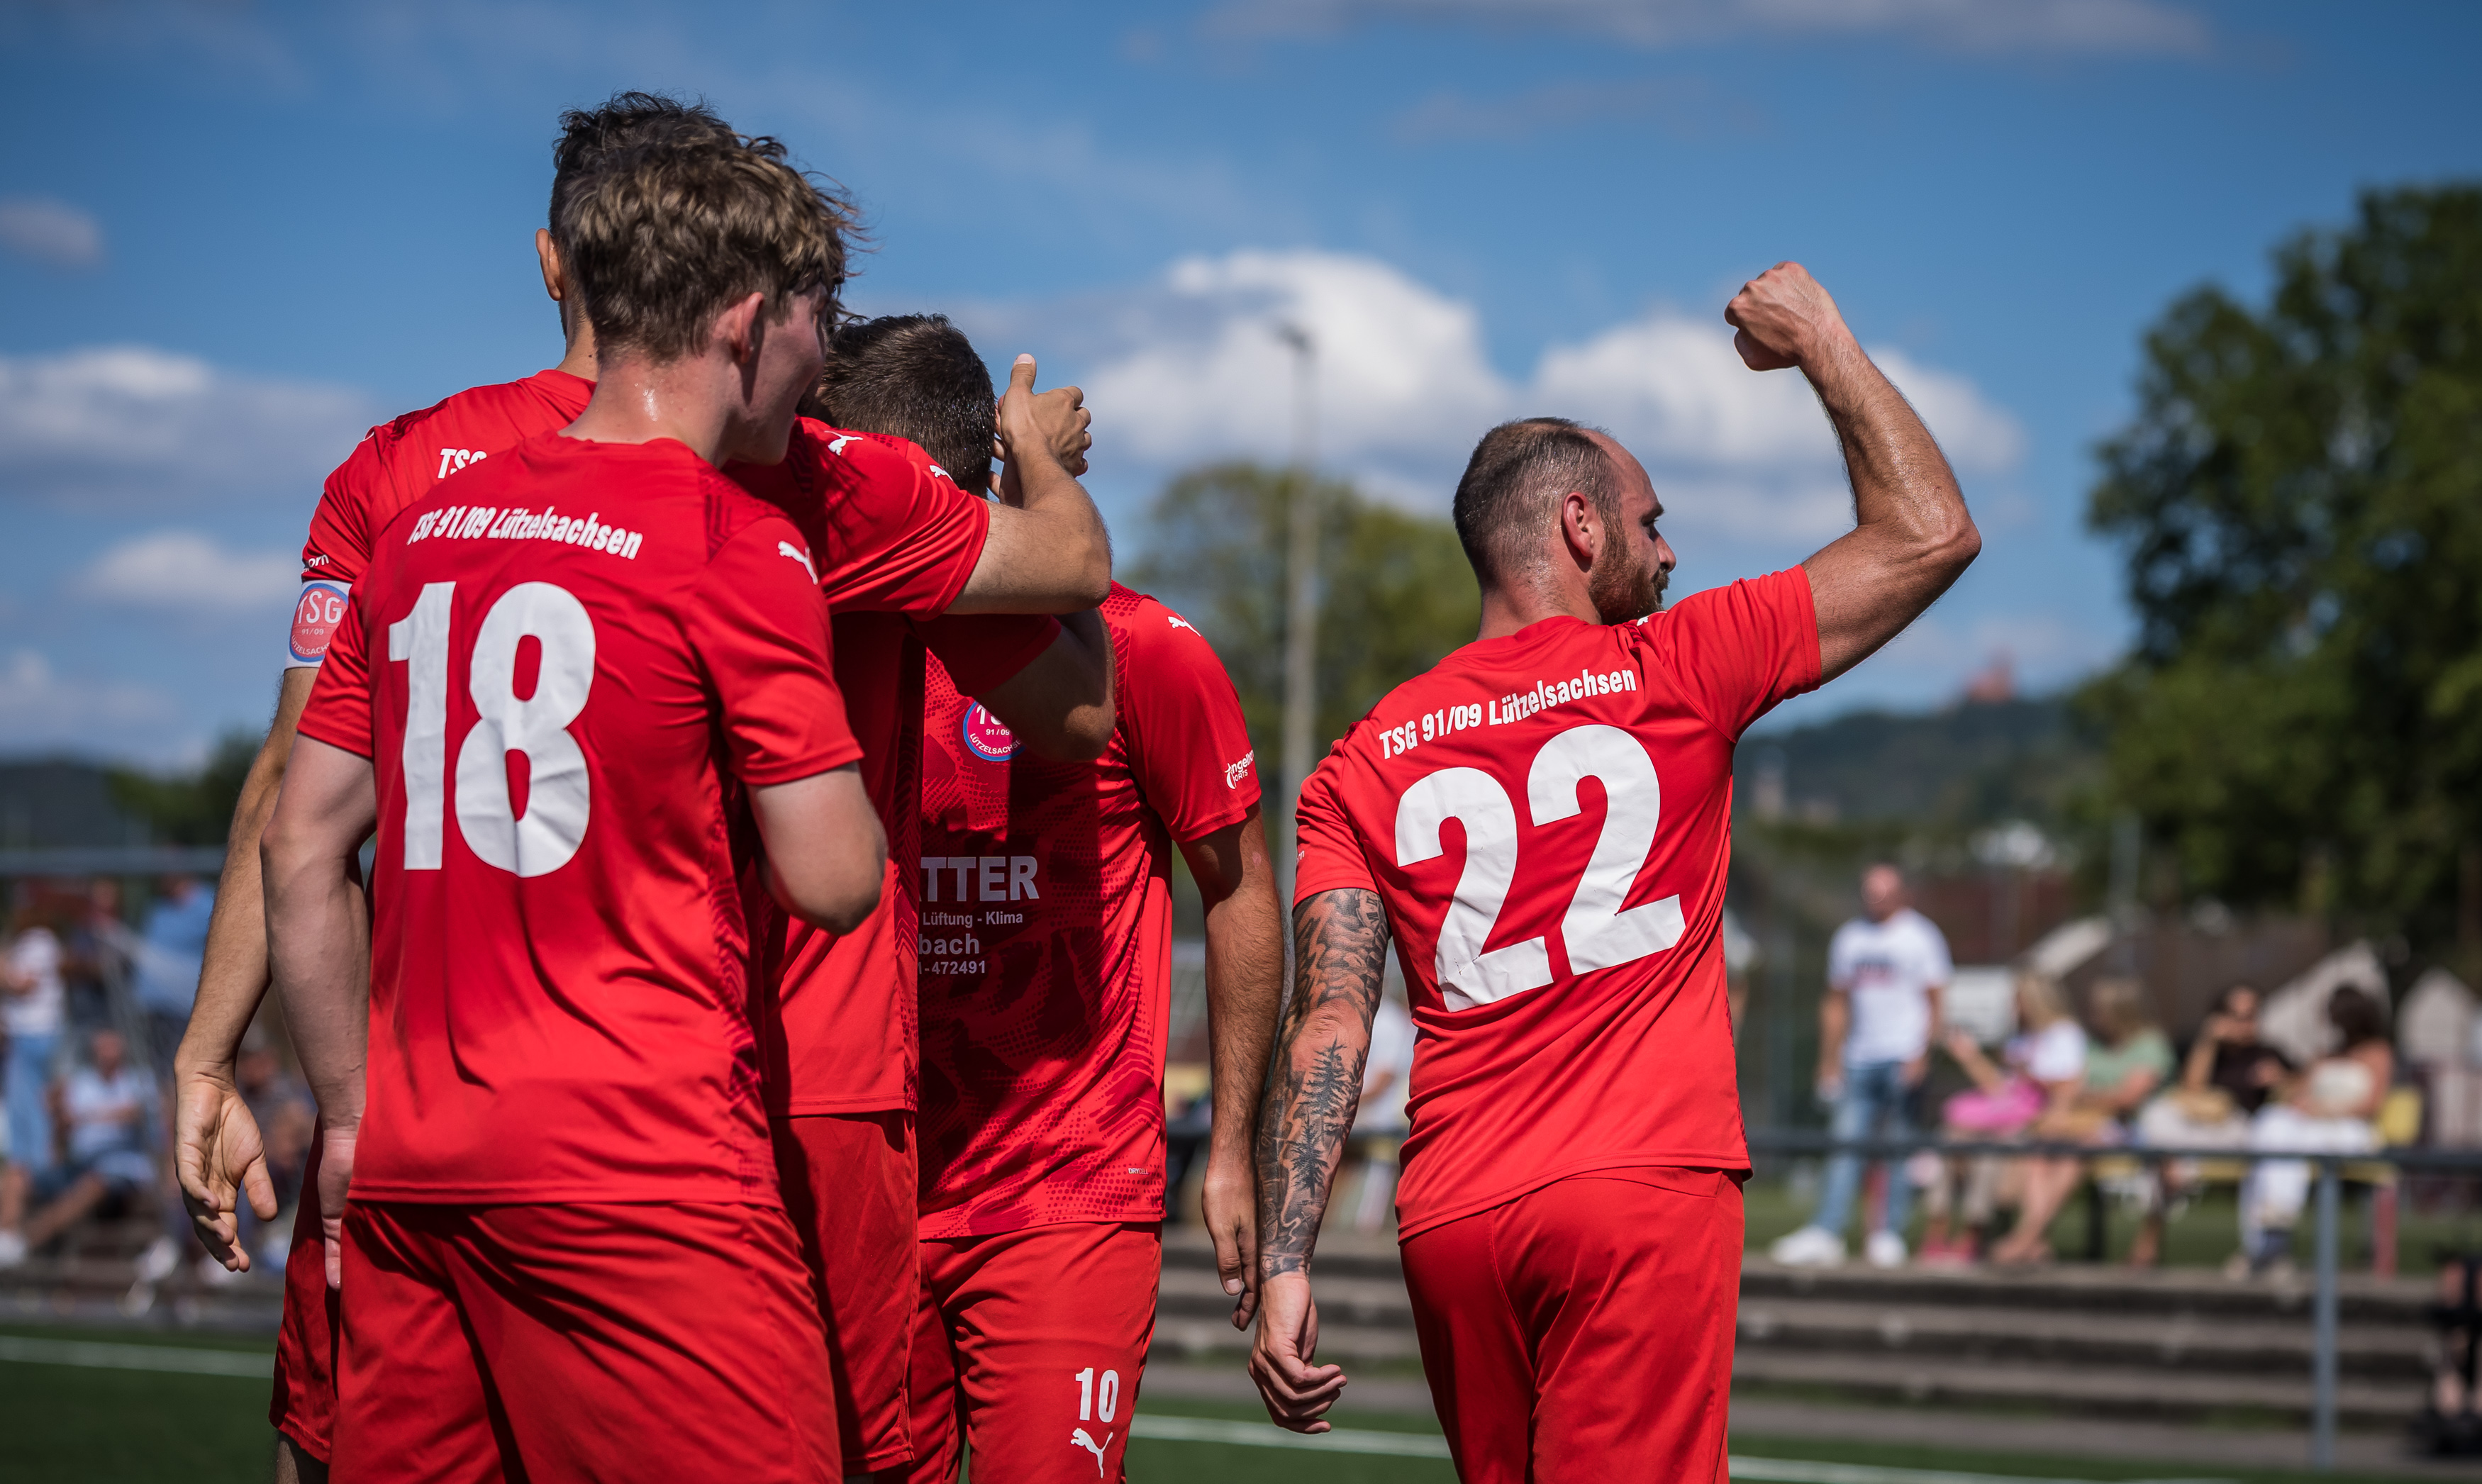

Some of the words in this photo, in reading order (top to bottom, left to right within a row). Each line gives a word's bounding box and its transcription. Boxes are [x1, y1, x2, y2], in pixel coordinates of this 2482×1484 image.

[406, 508, 443, 546] TSG
[433, 505, 497, 540] 91/09
[486, 505, 643, 560] Lützelsachsen
[297, 590, 343, 625] TSG
[388, 580, 596, 878] 18
[1379, 724, 1418, 760] TSG
[1422, 703, 1482, 743] 91/09
[1488, 669, 1637, 727] Lützelsachsen
[919, 855, 1040, 903] TTER
[1394, 724, 1686, 1012] 22
[918, 932, 980, 955] bach
[923, 912, 973, 929] Lüftung
[986, 910, 1023, 925] Klima
[1075, 1366, 1119, 1424] 10
